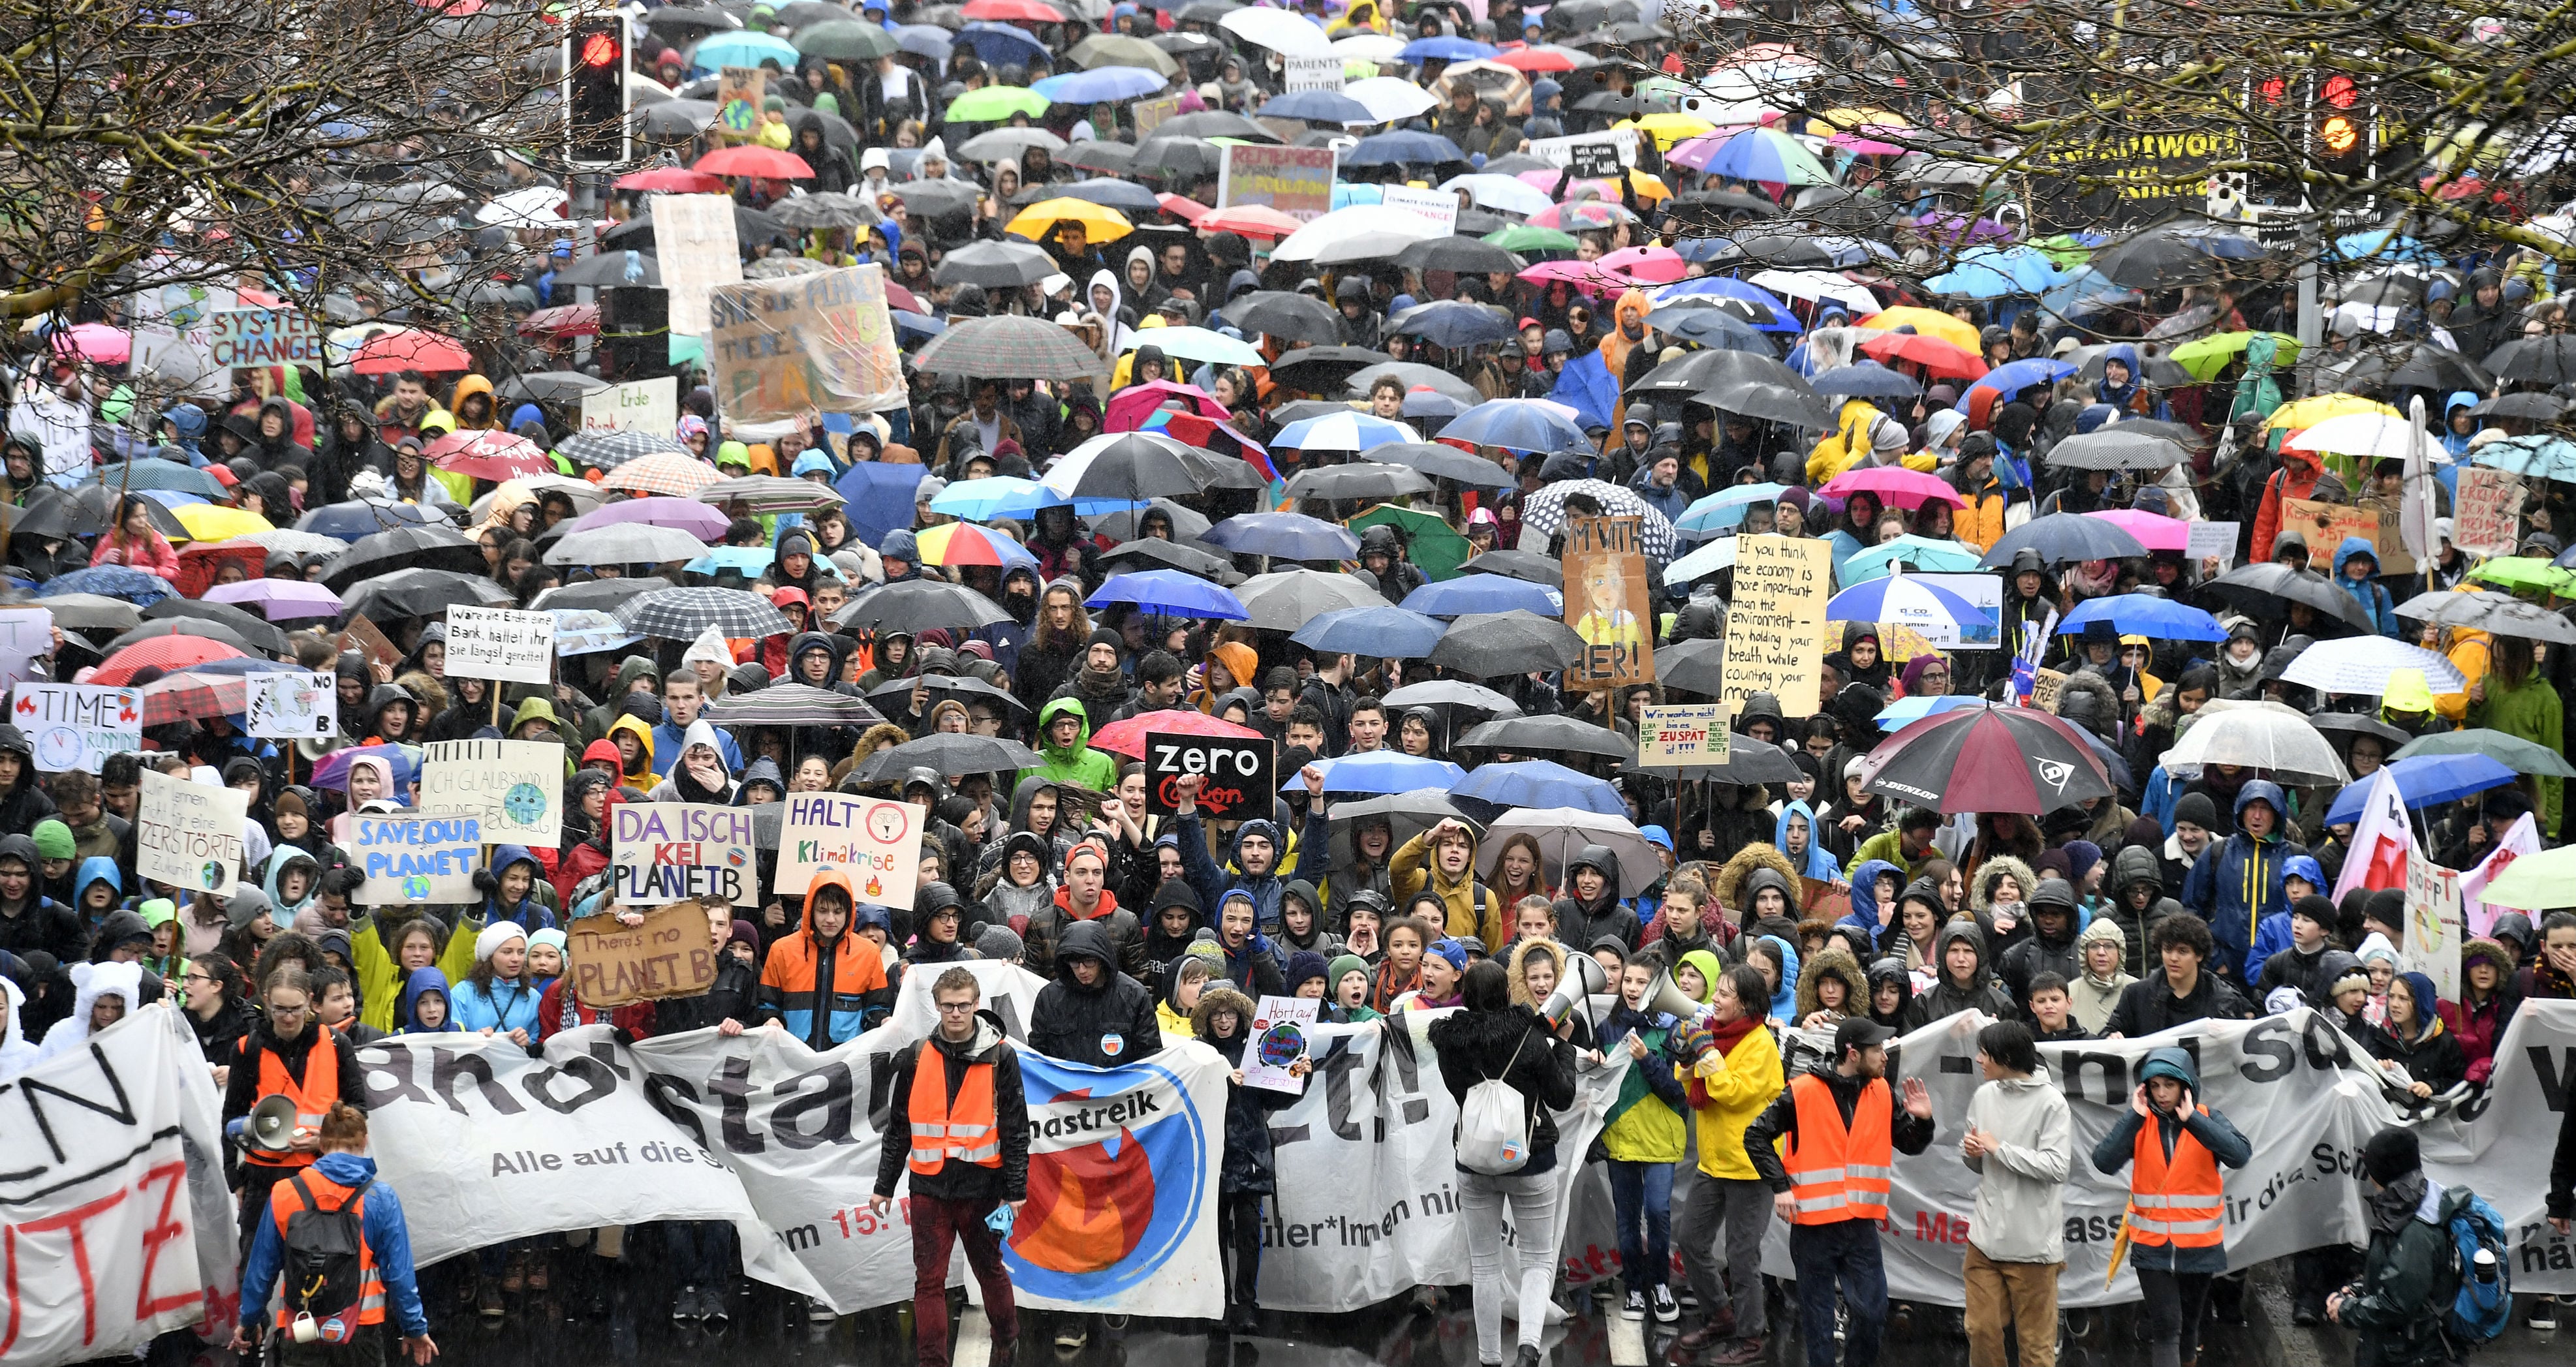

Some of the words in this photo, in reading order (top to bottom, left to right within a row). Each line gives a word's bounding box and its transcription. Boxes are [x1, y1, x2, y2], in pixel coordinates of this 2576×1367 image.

[1288, 59, 1341, 70] PARENTS
[1597, 161, 1619, 175] WIR
[805, 270, 879, 308] PLANET
[213, 335, 322, 366] CHANGE
[620, 386, 649, 408] Erde
[1597, 521, 1644, 555] WITH
[1739, 536, 1751, 553] If
[1756, 546, 1774, 561] you
[1781, 540, 1808, 561] think
[1736, 560, 1751, 575] the
[1756, 564, 1795, 582] economy
[1802, 564, 1812, 581] is
[1734, 580, 1759, 591] more
[1763, 579, 1813, 598] important
[1732, 595, 1756, 610] than
[1760, 598, 1776, 611] the
[486, 610, 499, 621] die
[503, 611, 527, 624] Erde
[531, 615, 552, 626] eine
[1731, 611, 1796, 630] environment
[529, 628, 548, 646] ihr
[1729, 628, 1745, 647] try
[1749, 628, 1781, 651] holding
[1789, 637, 1814, 651] your
[448, 643, 466, 656] sie
[505, 650, 544, 666] gerettet
[1570, 641, 1639, 681] HER!
[1729, 644, 1761, 664] breath
[1767, 653, 1799, 666] while
[313, 675, 332, 689] NO
[1726, 668, 1772, 690] counting
[1779, 673, 1807, 690] your
[38, 689, 117, 730] TIME
[248, 688, 268, 731] PLANET
[1645, 709, 1664, 719] Wir
[1666, 708, 1694, 718] warten
[1696, 707, 1716, 718] nicht
[316, 715, 330, 731] B
[1666, 719, 1678, 729] bis
[86, 730, 142, 753] RUNNING
[1659, 731, 1677, 742] ZU
[1677, 728, 1707, 741] SPÄT
[1155, 744, 1260, 777] zero
[1666, 744, 1675, 755] ist
[144, 777, 165, 795] Wir
[430, 771, 453, 793] ICH
[1885, 780, 1939, 801] DUNLOP
[1158, 774, 1245, 814] Cabon
[142, 801, 166, 820] nicht
[172, 803, 187, 827] für
[191, 813, 217, 830] eine
[790, 798, 861, 829] HALT
[875, 812, 899, 825] STOP
[358, 820, 420, 846] SAVE
[424, 819, 480, 844] OUR
[617, 808, 670, 842] DA
[681, 808, 751, 846] ISCH
[140, 820, 243, 862] ZERSTÖRTE
[366, 848, 478, 879] PLANET
[655, 842, 701, 866] KEI
[797, 839, 895, 872] Klimakrise
[151, 853, 193, 880] Zukunft
[653, 927, 681, 945] no
[578, 952, 680, 998] PLANET
[689, 947, 714, 984] B
[1296, 1007, 1316, 1023] auf
[491, 1150, 563, 1178] Alle
[573, 1141, 630, 1167] auf
[640, 1140, 694, 1164] die
[775, 1222, 821, 1252] m
[831, 1204, 890, 1241] 15.
[1916, 1211, 1970, 1244] Mä
[2224, 1191, 2252, 1227] ir
